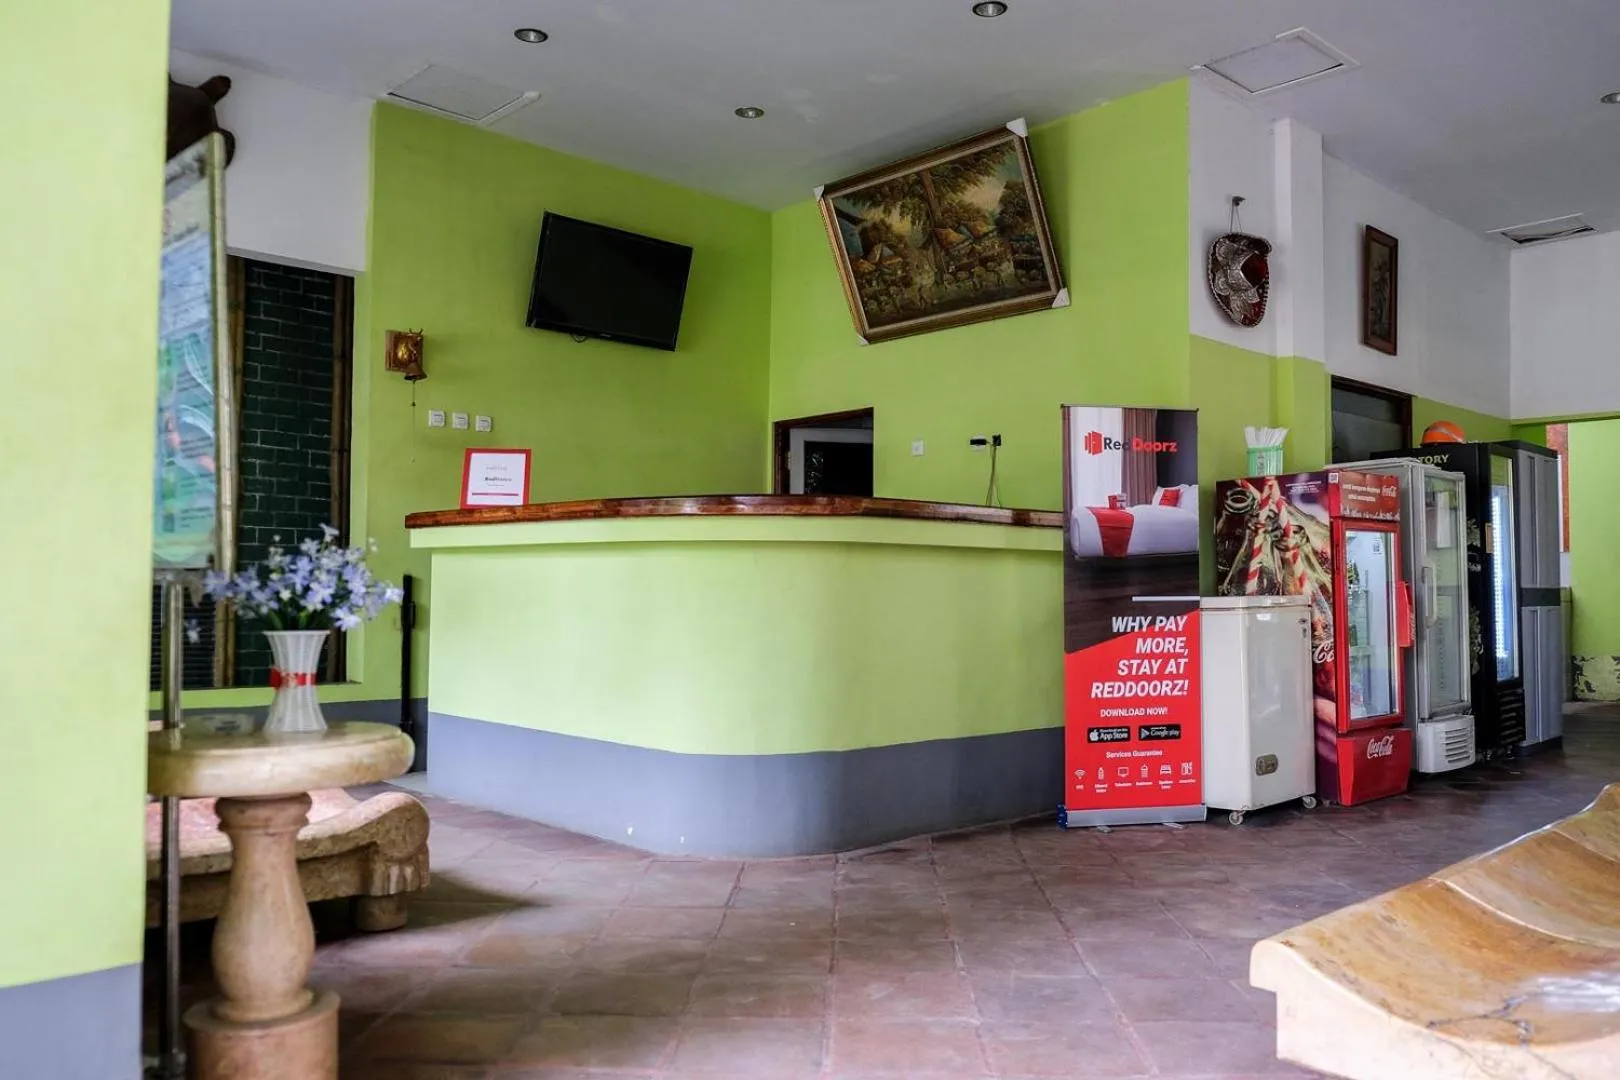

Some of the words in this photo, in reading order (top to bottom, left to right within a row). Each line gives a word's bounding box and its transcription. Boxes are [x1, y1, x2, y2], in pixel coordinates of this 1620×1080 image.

[1112, 616, 1152, 632] WHY
[1154, 615, 1188, 632] PAY
[1136, 637, 1189, 656] MORE,
[1118, 659, 1162, 675] STAY
[1164, 658, 1189, 675] AT
[1091, 679, 1189, 698] REDDOORZ!
[1100, 708, 1145, 717] DOWNLOAD
